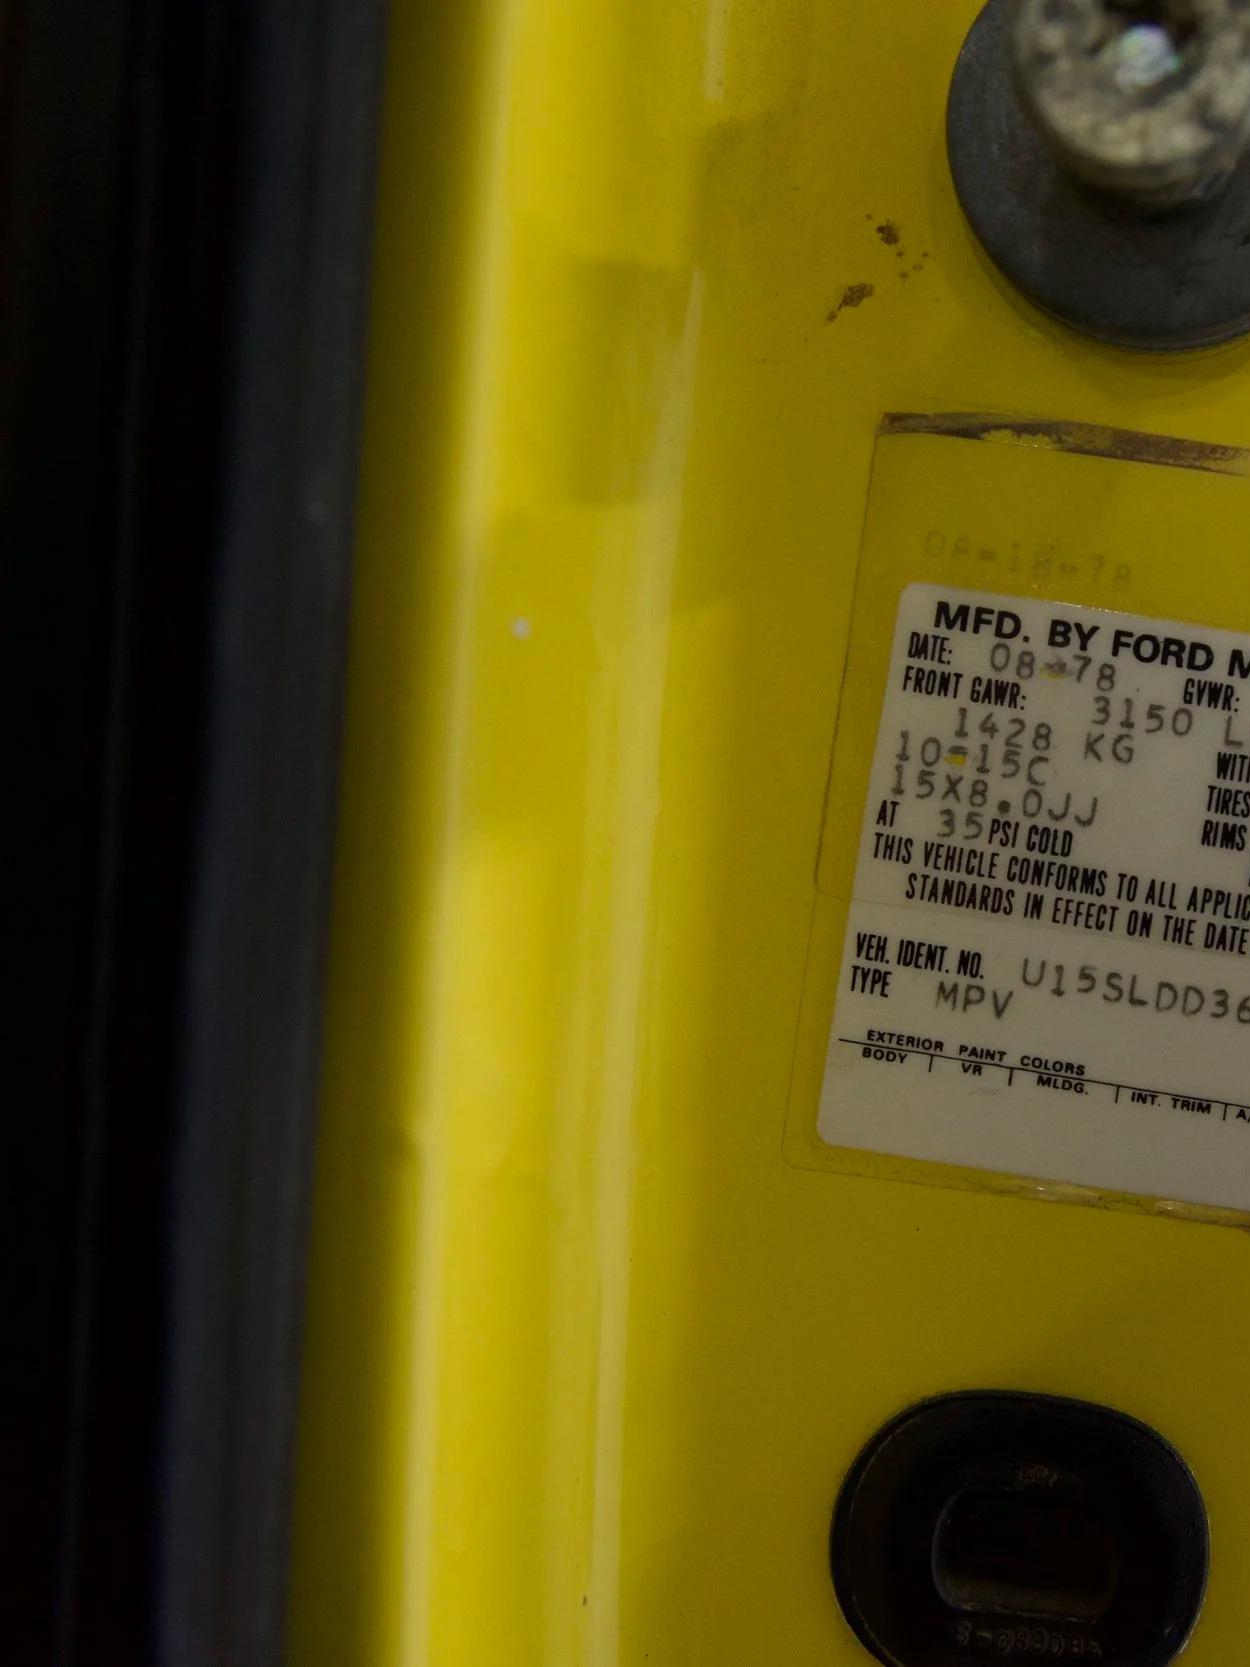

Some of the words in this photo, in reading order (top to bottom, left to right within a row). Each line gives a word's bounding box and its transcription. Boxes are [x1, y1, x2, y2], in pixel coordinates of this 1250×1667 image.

[908, 631, 953, 666] DATE:
[934, 601, 1030, 643] MFD.
[1047, 618, 1100, 652] BY
[1112, 629, 1214, 672] FORD
[902, 665, 963, 700] FRONT
[970, 675, 1027, 711] GAWR:
[1092, 695, 1194, 737] 3150
[1183, 677, 1240, 713] GVWR:
[953, 707, 1052, 751] 1428
[1084, 732, 1135, 764] KG
[876, 800, 900, 828] AT
[936, 808, 984, 840] 35
[988, 819, 1018, 848] PSI
[1026, 824, 1074, 858] COLD
[1200, 820, 1249, 852] RIMS
[872, 832, 914, 865] THIS
[923, 841, 1000, 880] VEHICLE
[1006, 855, 1108, 898] CONFORMS
[1116, 873, 1138, 903] TO
[1144, 879, 1177, 911] ALL
[905, 872, 1016, 917] STANDARDS
[1023, 891, 1043, 921] IN
[1051, 896, 1119, 934] EFFECT
[1126, 909, 1155, 939] ON
[1163, 915, 1196, 946] THE
[1203, 921, 1250, 955] DATE
[855, 931, 890, 965] VEH.
[896, 939, 950, 974] IDENT.
[956, 949, 985, 980] NO.
[850, 965, 893, 999] TYPE
[934, 980, 1015, 1020] MPV
[861, 1046, 908, 1065] BODY
[866, 1029, 944, 1052] EXTERIOR
[958, 1045, 1008, 1063] PAINT
[1020, 1055, 1086, 1077] COLORS
[961, 1063, 983, 1077] VR
[1036, 1075, 1090, 1095] MLDG.
[1130, 1091, 1161, 1107] INT.
[1171, 1097, 1212, 1115] TRIM
